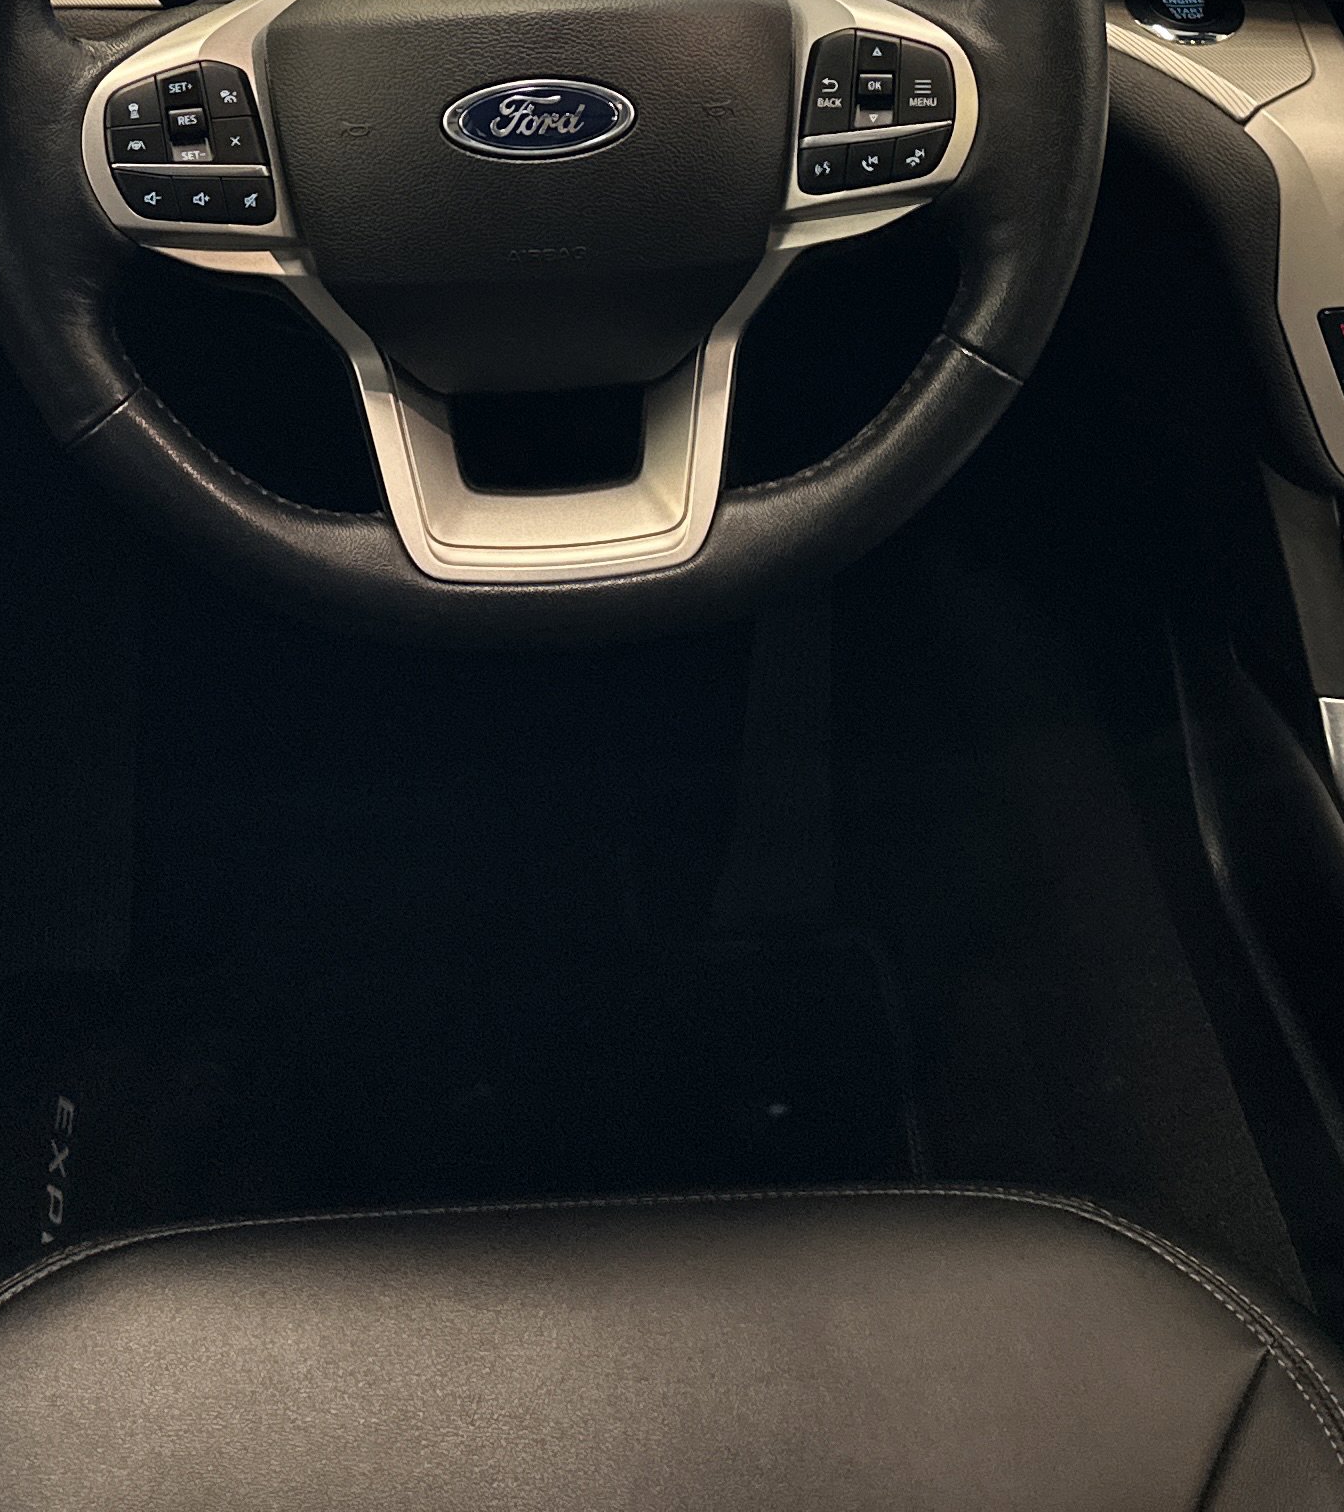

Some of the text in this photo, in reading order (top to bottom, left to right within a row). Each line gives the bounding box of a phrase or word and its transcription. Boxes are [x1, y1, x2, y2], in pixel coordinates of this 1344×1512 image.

[867, 81, 882, 91] OK
[817, 98, 842, 108] BACK
[909, 97, 937, 107] MENU
[177, 115, 198, 126] RES
[490, 94, 586, 137] Ford
